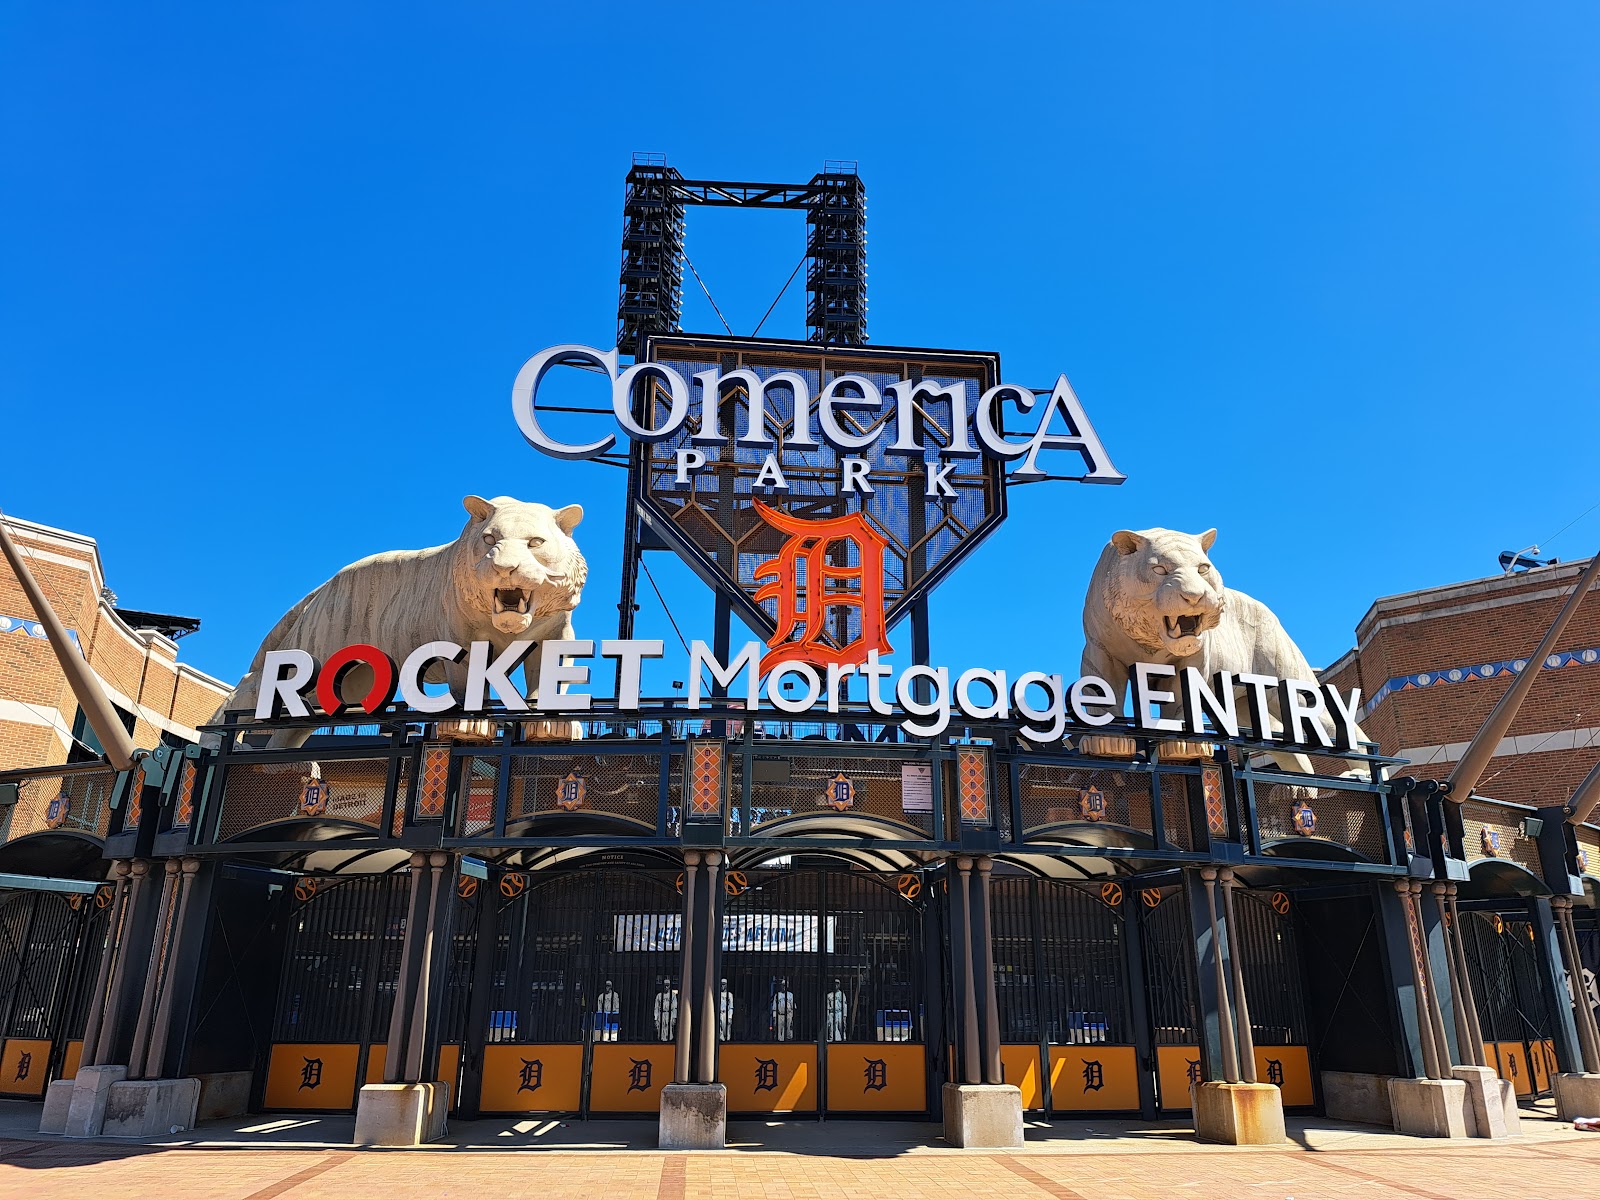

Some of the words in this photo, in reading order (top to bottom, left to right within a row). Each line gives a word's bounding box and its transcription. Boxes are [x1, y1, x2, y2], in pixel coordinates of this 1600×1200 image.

[674, 447, 960, 502] PARK
[752, 496, 894, 678] D
[254, 638, 664, 721] ROCKET
[687, 639, 1119, 743] Mortgage
[1129, 661, 1363, 752] ENTRY
